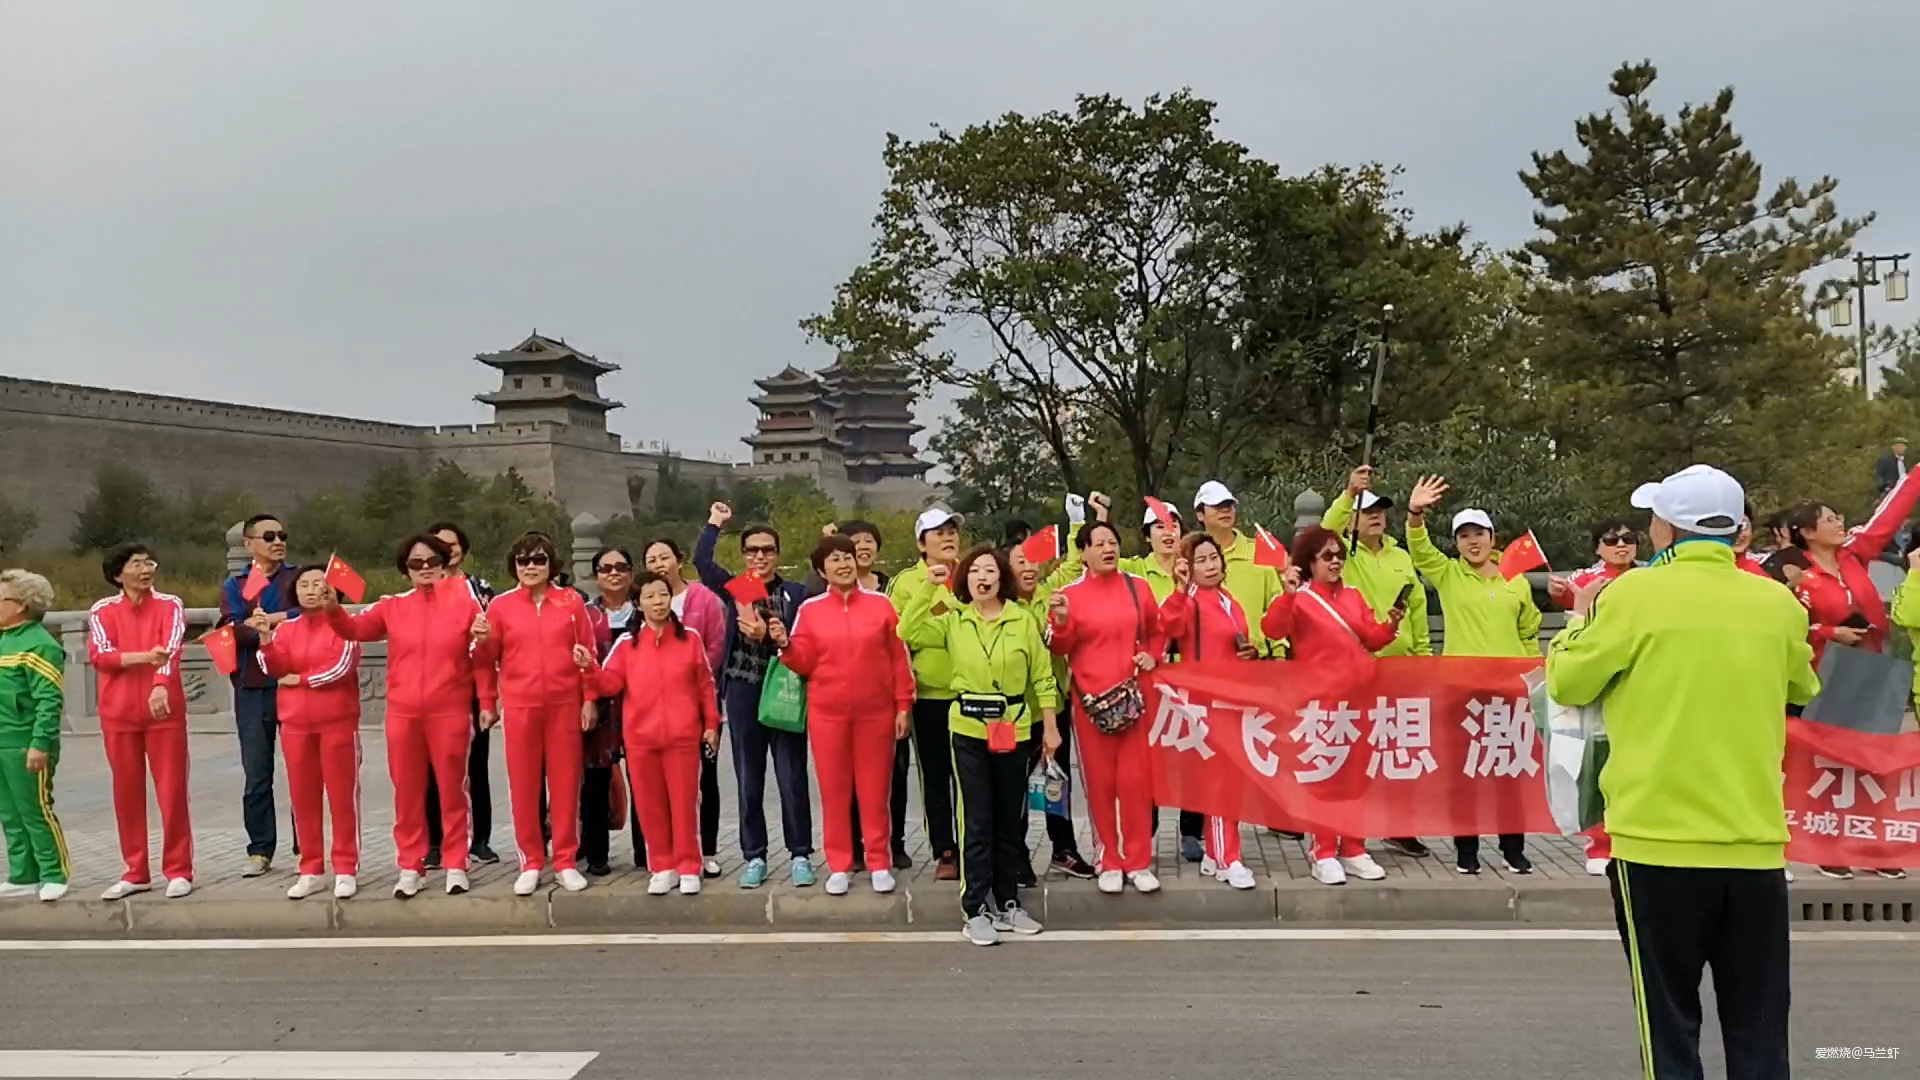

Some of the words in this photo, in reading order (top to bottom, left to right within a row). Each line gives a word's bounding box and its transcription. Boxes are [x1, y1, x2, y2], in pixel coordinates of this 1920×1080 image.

[1148, 683, 1439, 783] 放飞梦想
[1461, 697, 1540, 778] 激
